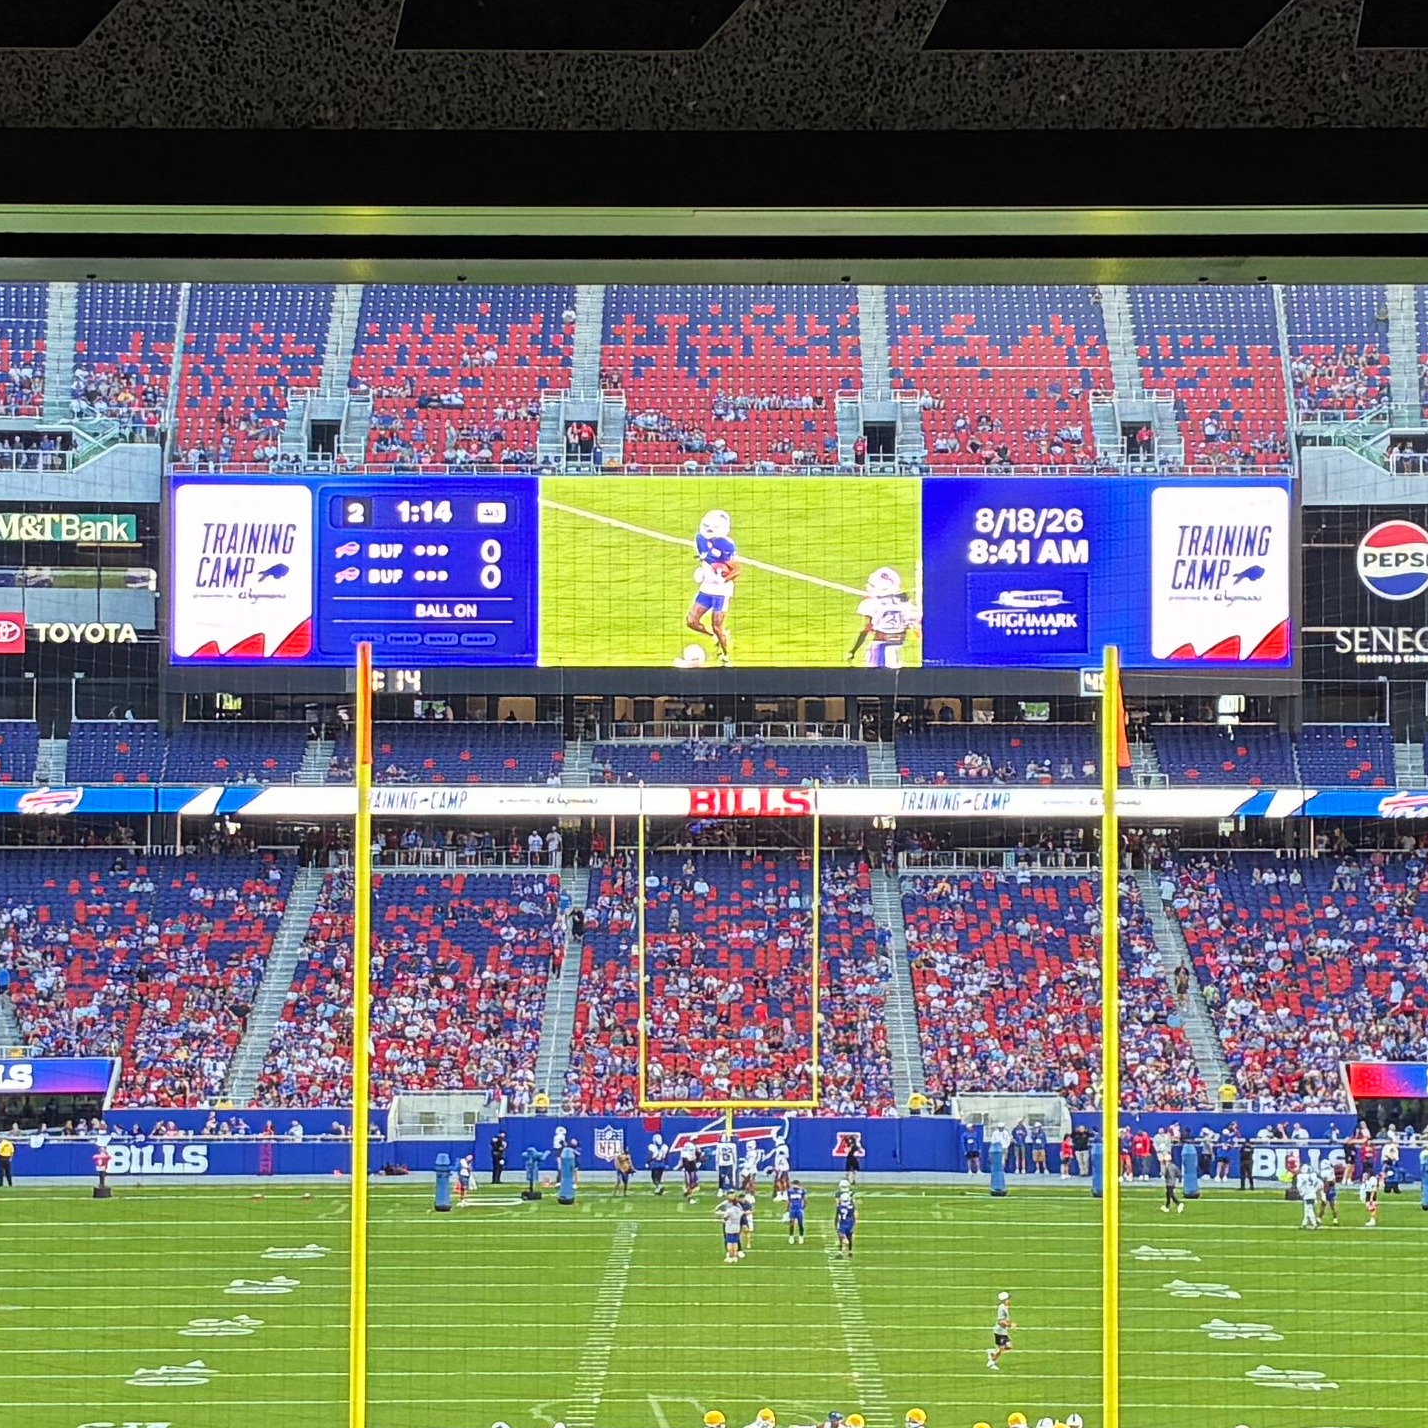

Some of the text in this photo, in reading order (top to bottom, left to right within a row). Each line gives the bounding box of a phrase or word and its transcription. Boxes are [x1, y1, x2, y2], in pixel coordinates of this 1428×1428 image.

[347, 503, 365, 523] 2
[397, 500, 453, 523] 1:14
[975, 508, 1084, 539] 8/18/26
[61, 514, 130, 541] Bank
[203, 523, 296, 554] TRAINING
[368, 539, 502, 563] BUF 0
[968, 539, 1089, 564] 8:41 AM
[1178, 525, 1272, 556] TRAINING
[196, 557, 255, 588] CAMP
[368, 565, 502, 589] BUF 0
[1171, 560, 1231, 590] CAMP
[416, 604, 477, 618] BALL ON
[985, 612, 1077, 629] HIGHMARK
[34, 622, 139, 644] TOYOTA
[430, 790, 468, 811] CAMP
[690, 787, 815, 817] BILLS
[900, 791, 1010, 812] TRAINING CAMP
[107, 1144, 209, 1174] BILLS
